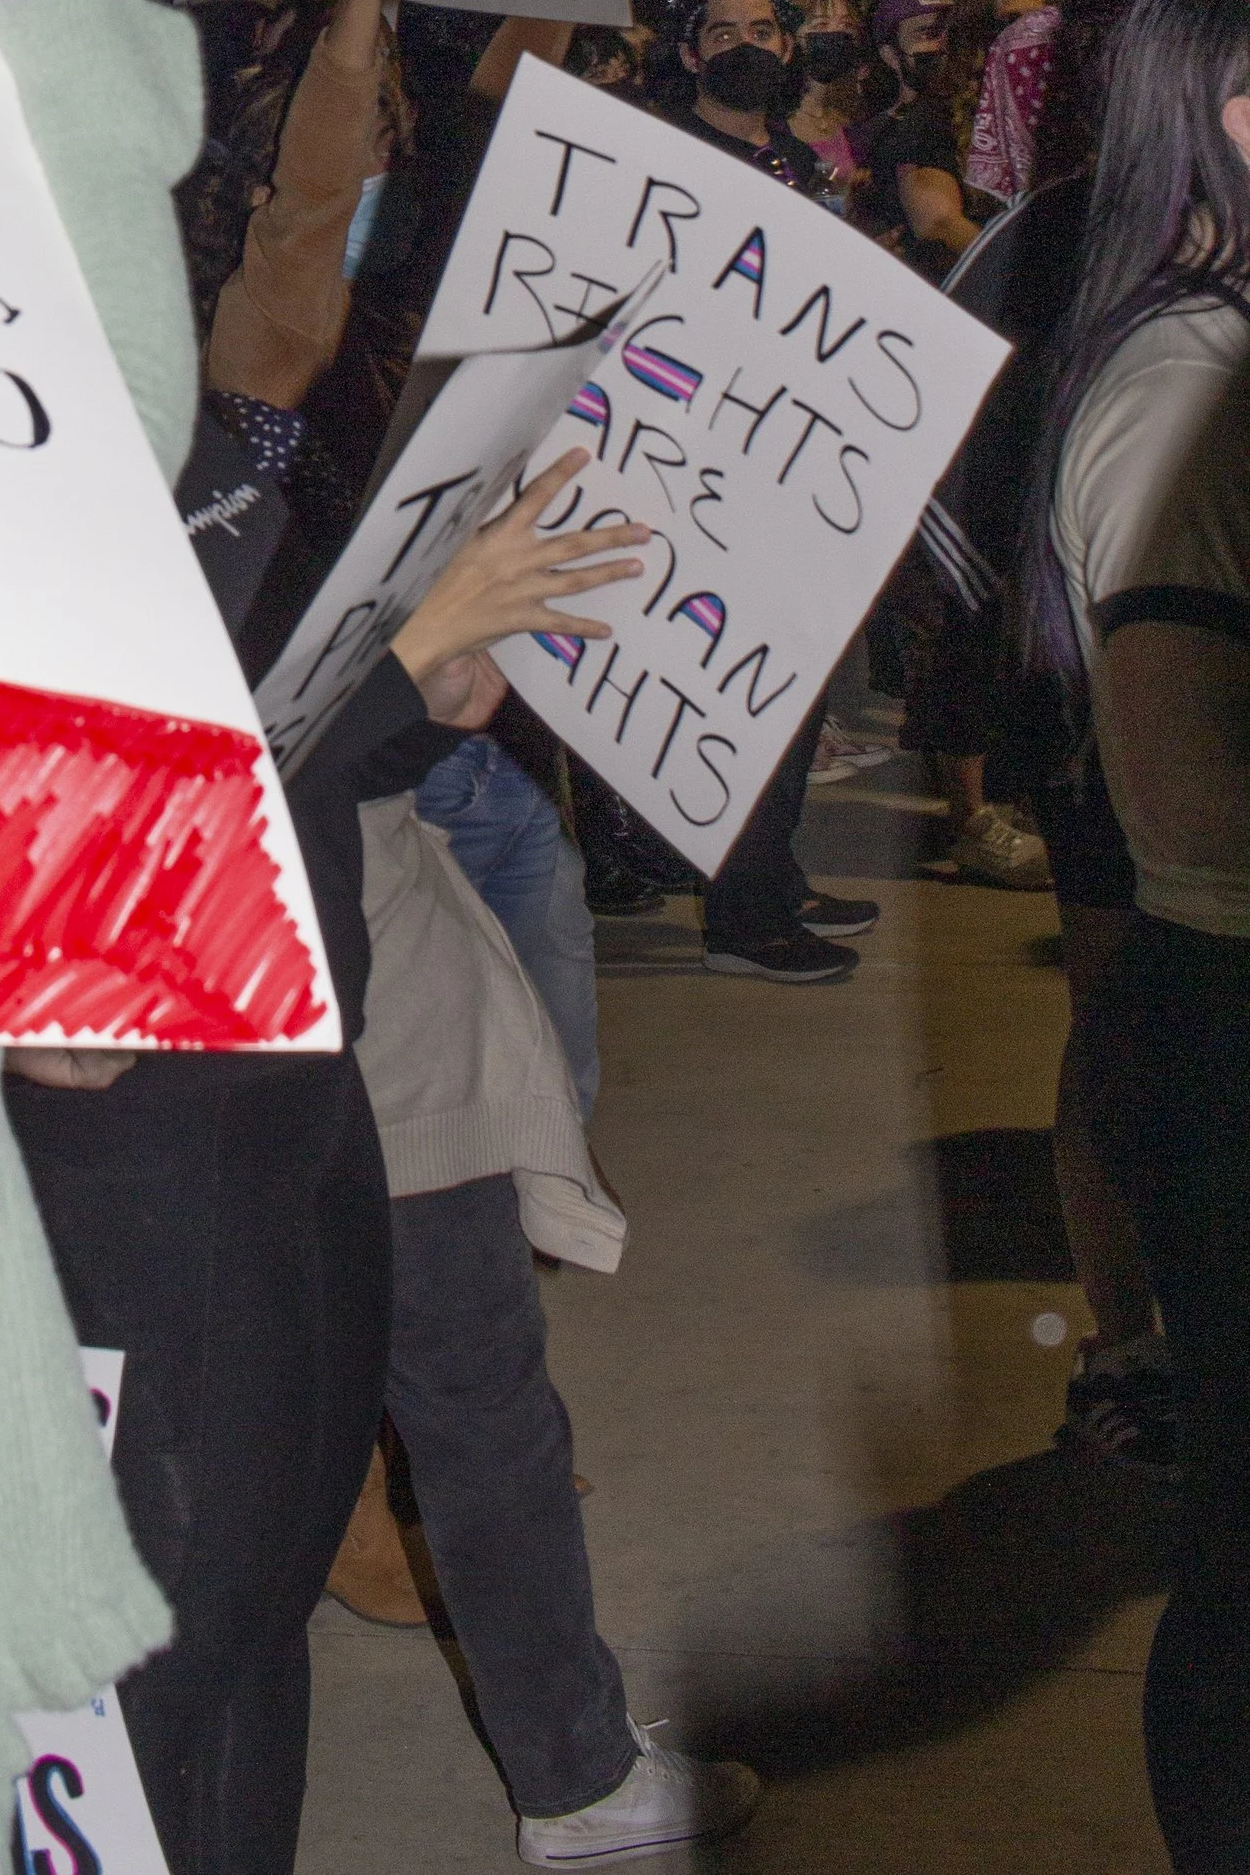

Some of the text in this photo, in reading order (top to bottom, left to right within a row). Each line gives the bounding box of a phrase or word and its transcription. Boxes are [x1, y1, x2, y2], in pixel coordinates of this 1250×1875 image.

[483, 229, 871, 534] RIGHTS
[535, 128, 922, 432] TRANS
[512, 463, 797, 718] UMAN
[530, 631, 738, 827] HTS
